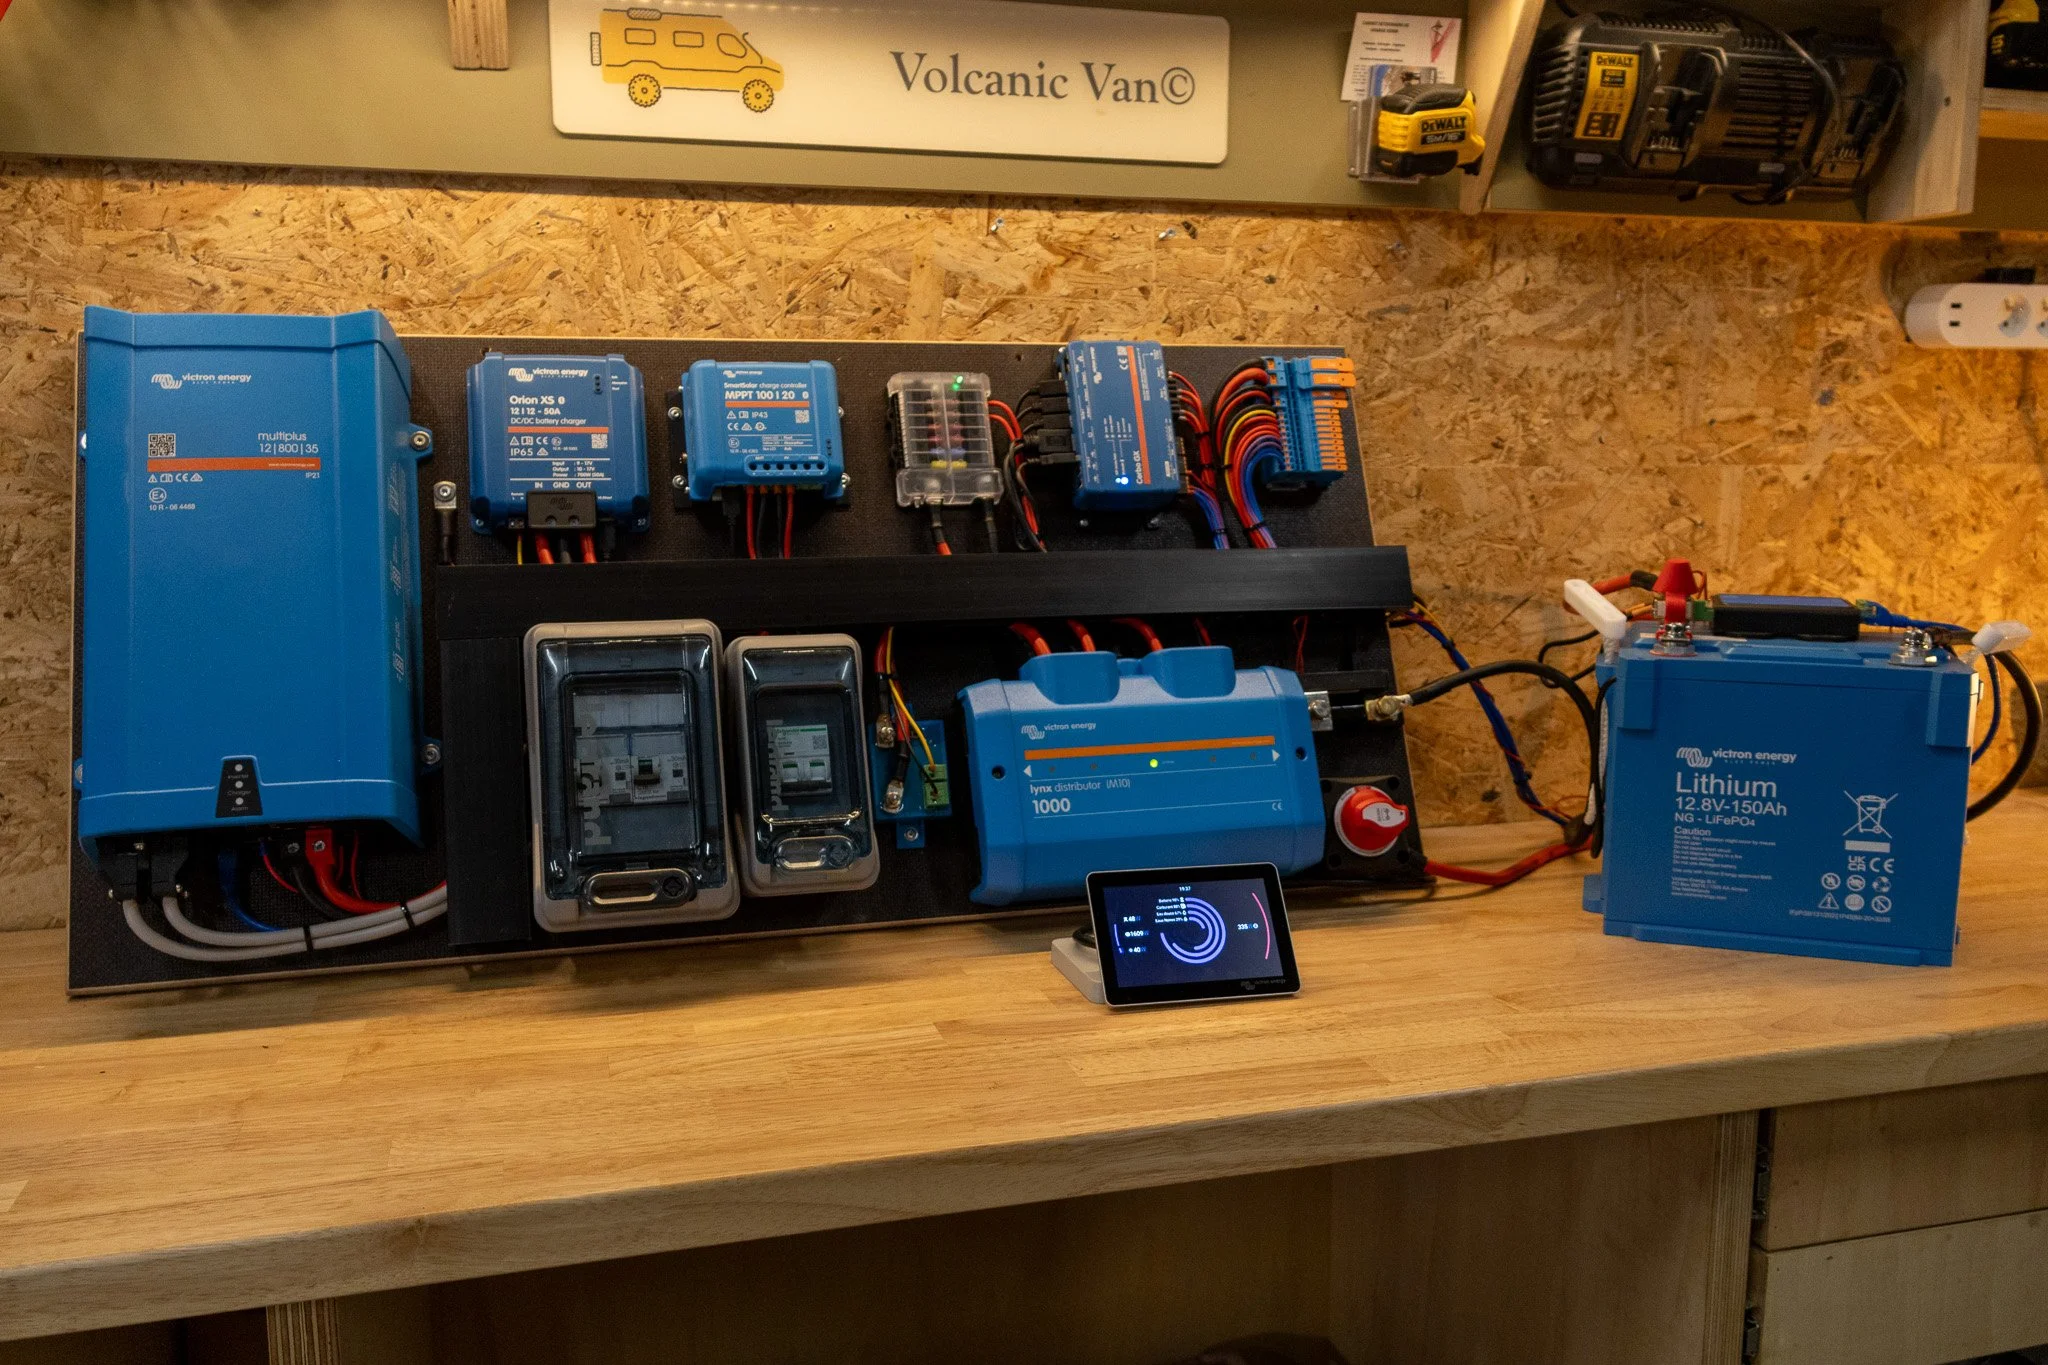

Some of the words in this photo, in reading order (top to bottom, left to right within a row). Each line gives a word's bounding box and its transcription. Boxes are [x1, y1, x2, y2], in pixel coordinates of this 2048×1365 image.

[890, 51, 1068, 99] Volcanic
[182, 373, 215, 381] victron
[218, 374, 251, 382] energy
[510, 396, 538, 404] Orion
[540, 396, 554, 404] XS
[725, 391, 753, 399] MPPT
[560, 418, 586, 426] charger
[258, 432, 306, 442] multiplus
[511, 448, 533, 456] IP65
[1133, 450, 1141, 462] GX
[1135, 463, 1143, 485] Cerbo
[1071, 722, 1096, 730] energy
[1712, 748, 1752, 760] victron
[1755, 752, 1797, 764] energy
[1030, 783, 1052, 794] lynx
[1054, 780, 1101, 793] distributor
[1676, 772, 1777, 798] Lithium
[1032, 798, 1071, 814] 1000
[1675, 796, 1787, 816] 12.8V-150Ah
[1674, 812, 1694, 823] NG
[1674, 826, 1711, 836] Caution
